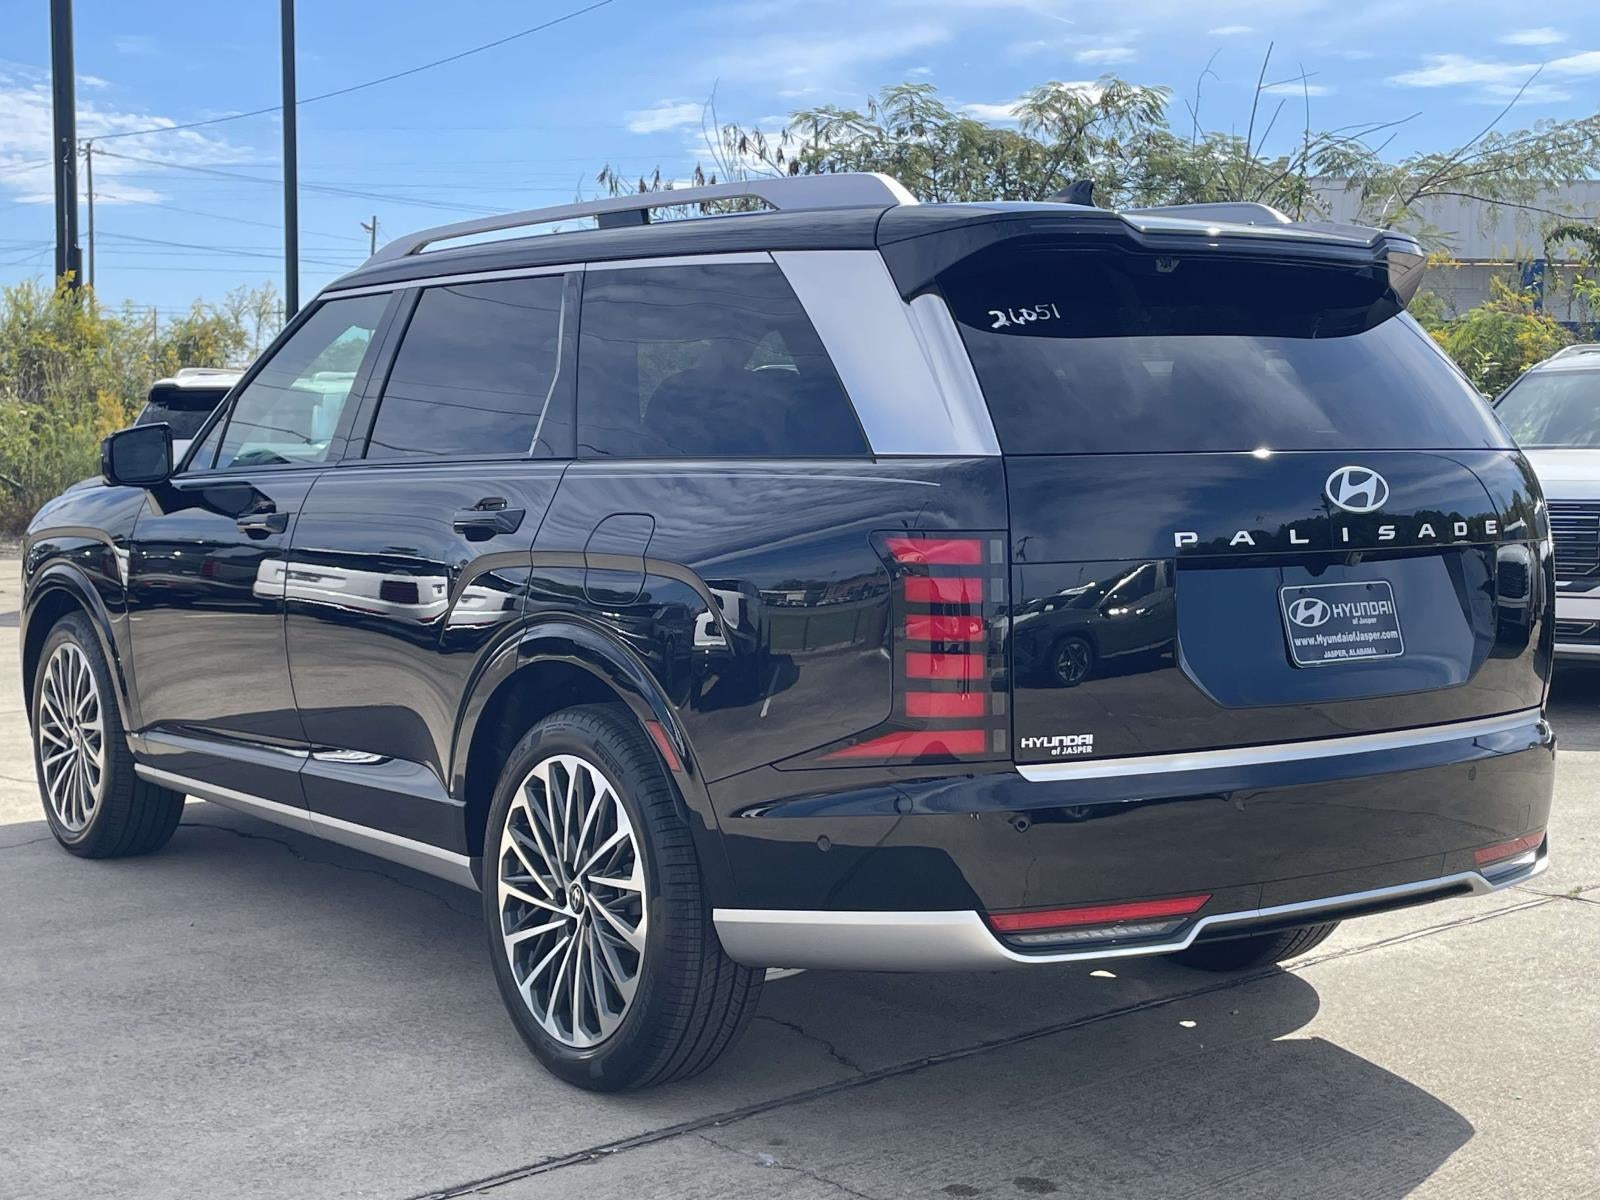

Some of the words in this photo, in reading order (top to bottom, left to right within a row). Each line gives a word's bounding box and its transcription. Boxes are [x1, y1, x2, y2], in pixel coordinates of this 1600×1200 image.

[988, 303, 1061, 328] 26051
[1174, 520, 1498, 548] PALISADE
[1332, 600, 1392, 618] HYUNDAI
[1359, 617, 1377, 625] Jasper
[1294, 630, 1398, 647] www.HyundaiofJasper.com
[1324, 648, 1348, 658] JASPER,
[1349, 647, 1377, 657] ALABAMA
[1021, 734, 1094, 748] HYUNDAI
[1051, 747, 1060, 755] of
[1062, 746, 1092, 755] JASPER
